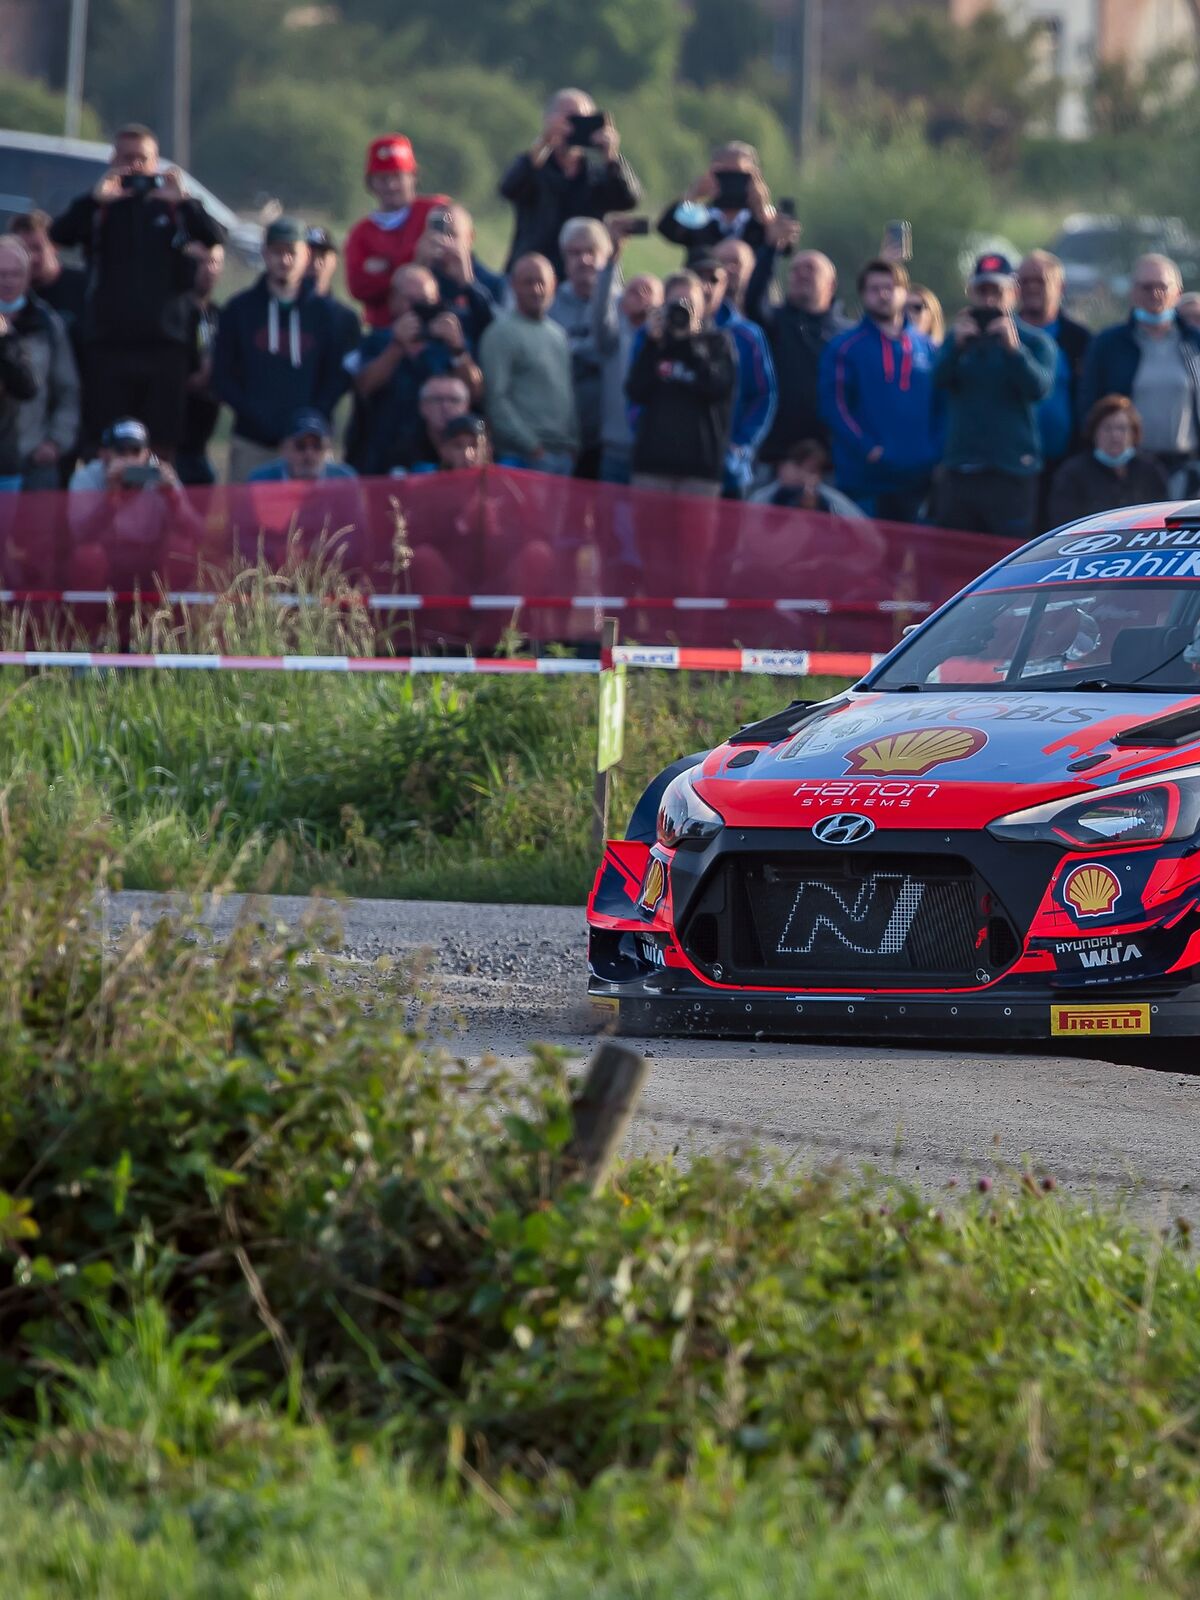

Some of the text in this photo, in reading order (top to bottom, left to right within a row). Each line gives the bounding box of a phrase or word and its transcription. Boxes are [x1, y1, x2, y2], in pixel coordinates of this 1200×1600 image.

[884, 704, 1107, 723] MOBIS
[800, 799, 912, 807] SYSTEMS
[642, 943, 666, 967] WIA
[1055, 937, 1112, 953] HYUNDAI
[1079, 942, 1142, 968] WIA
[1058, 1009, 1142, 1030] PIRELLI
